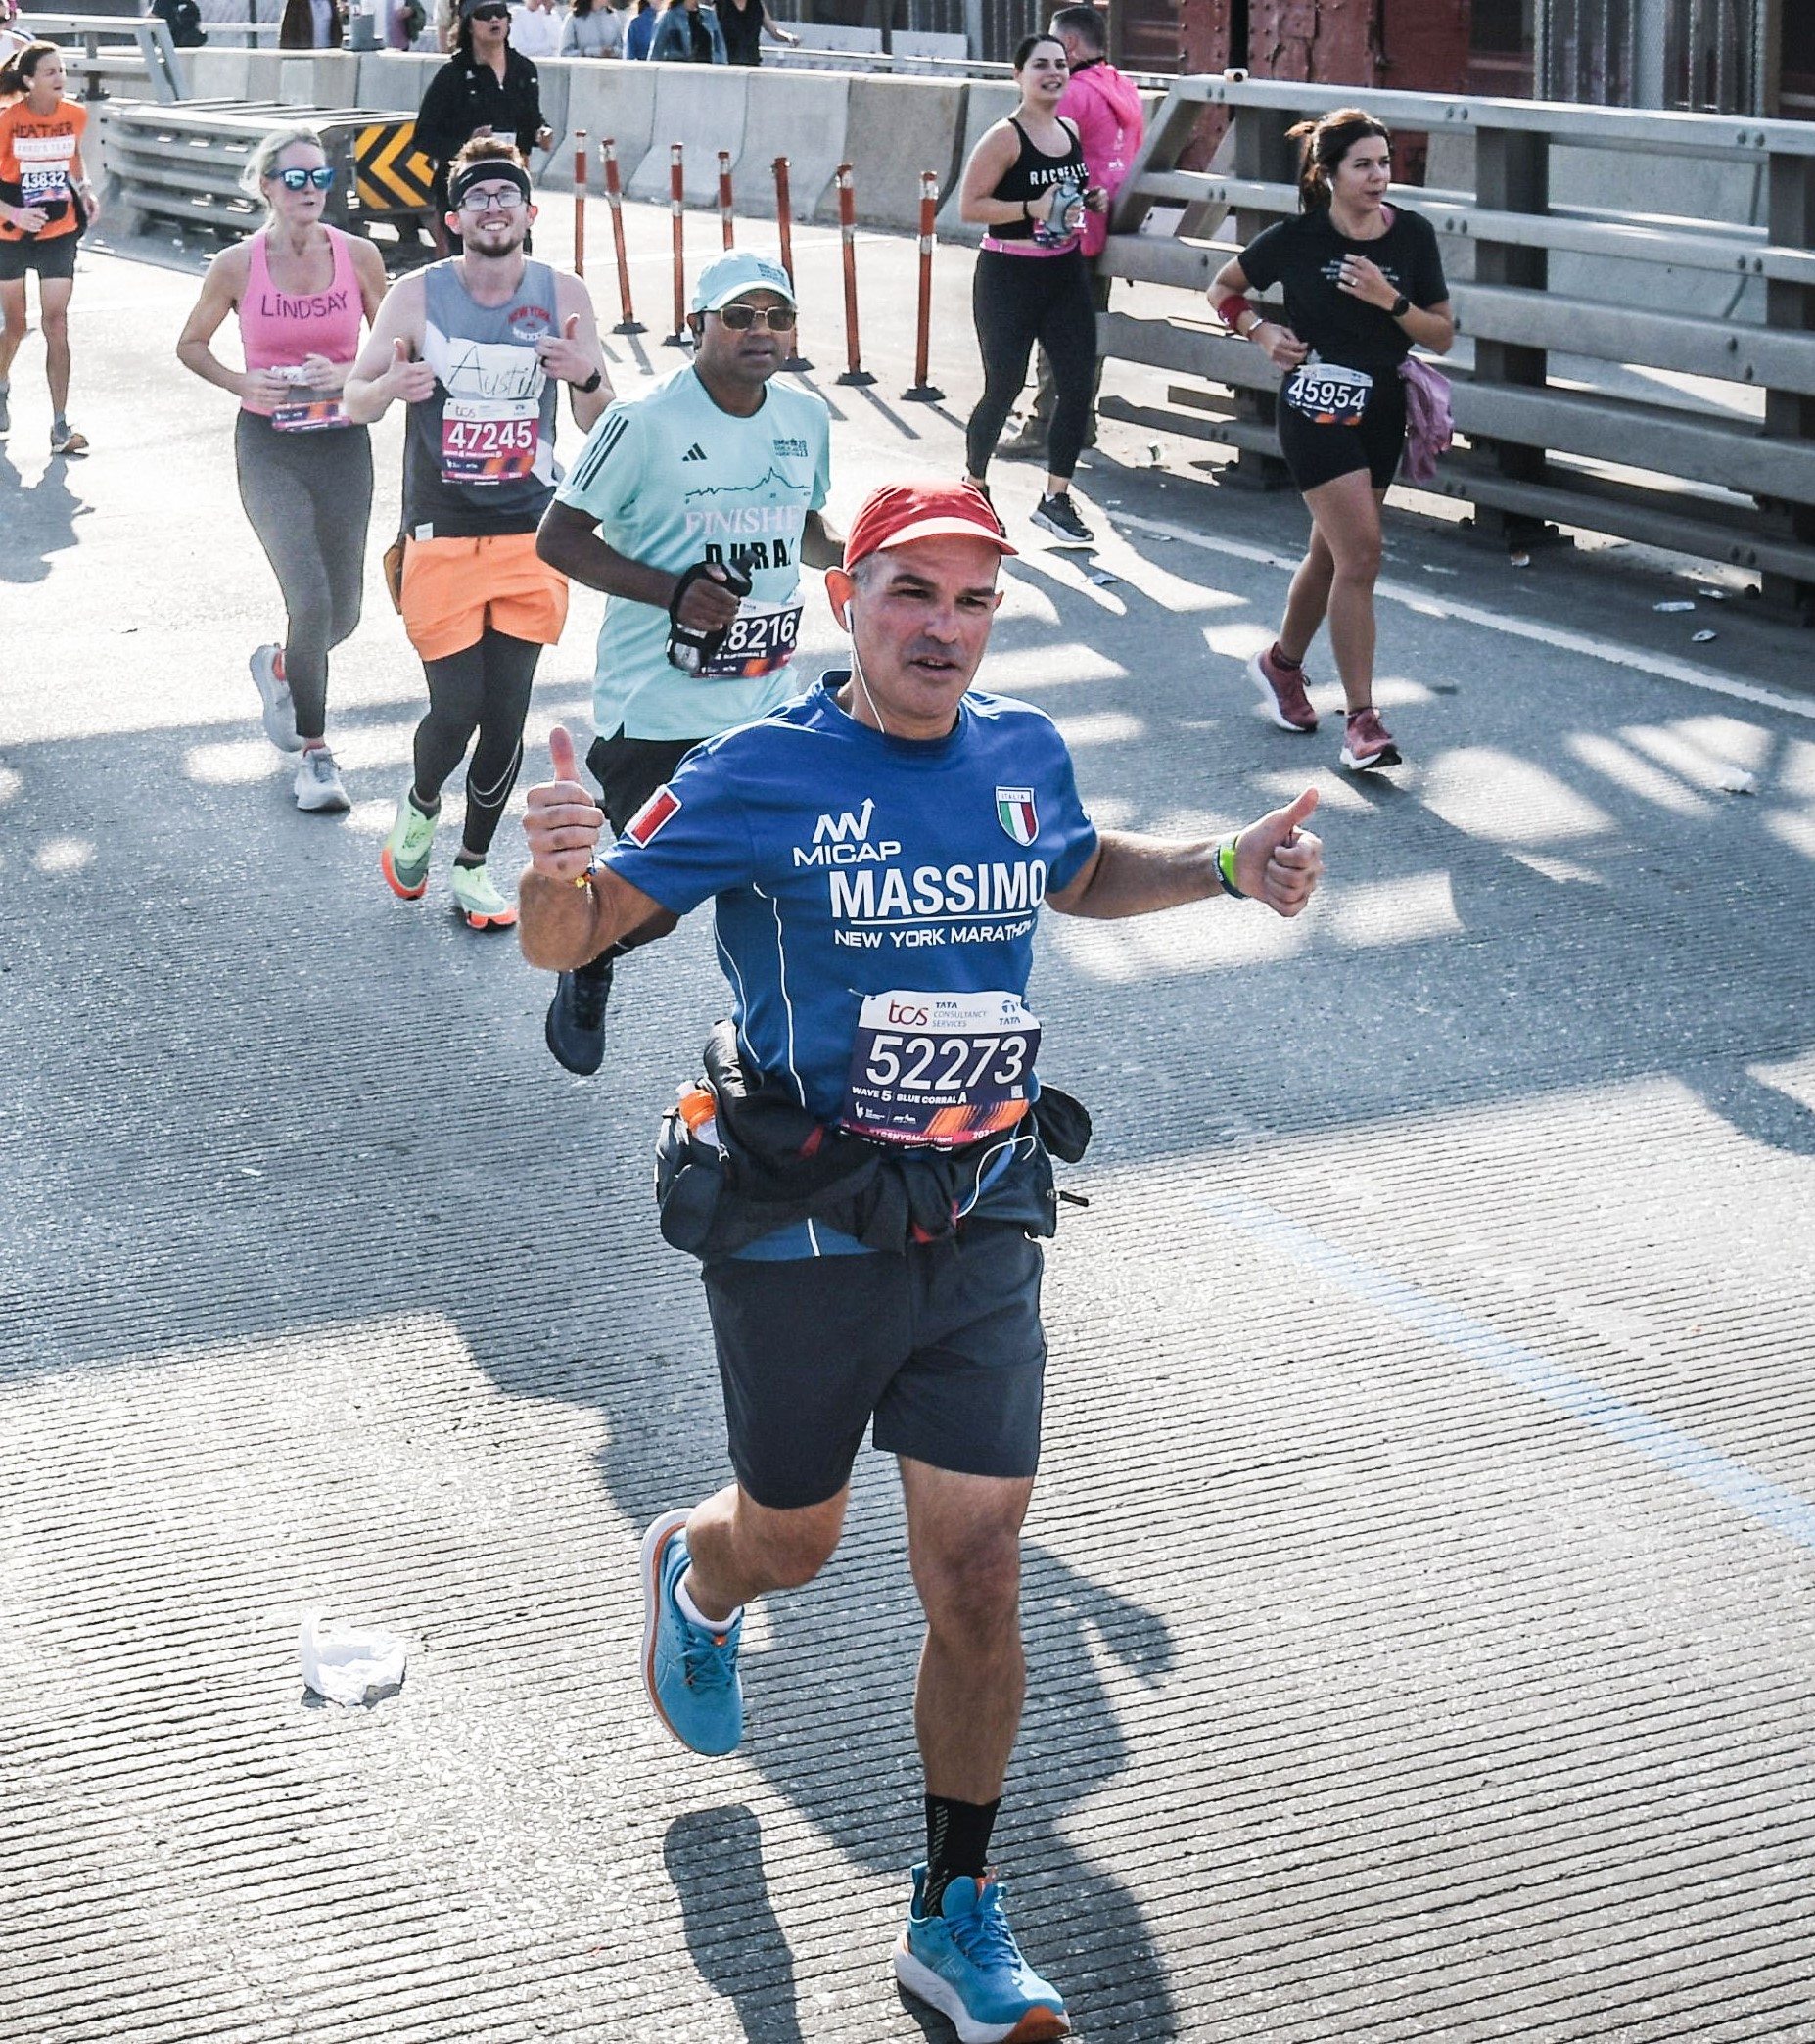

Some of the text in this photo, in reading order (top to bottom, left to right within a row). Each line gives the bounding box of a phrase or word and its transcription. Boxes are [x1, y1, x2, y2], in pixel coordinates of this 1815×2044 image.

[12, 121, 73, 138] HEATHER
[22, 171, 66, 189] 43832
[1287, 377, 1367, 411] 45954
[447, 420, 534, 451] 47245
[685, 504, 802, 535] FINISHE
[724, 611, 797, 652] 8216
[792, 840, 902, 867] MICAP
[828, 859, 1047, 919] MASSIMO
[834, 928, 883, 949] NEW
[889, 926, 946, 949] YORK
[888, 999, 929, 1027] tcs
[932, 1019, 968, 1028] SERVICES
[933, 1009, 987, 1019] CONSULTANCY
[999, 1016, 1021, 1026] TATA
[865, 1033, 1028, 1092] 52273
[852, 1086, 967, 1105] WAVE 5 BLUE CORRAL A
